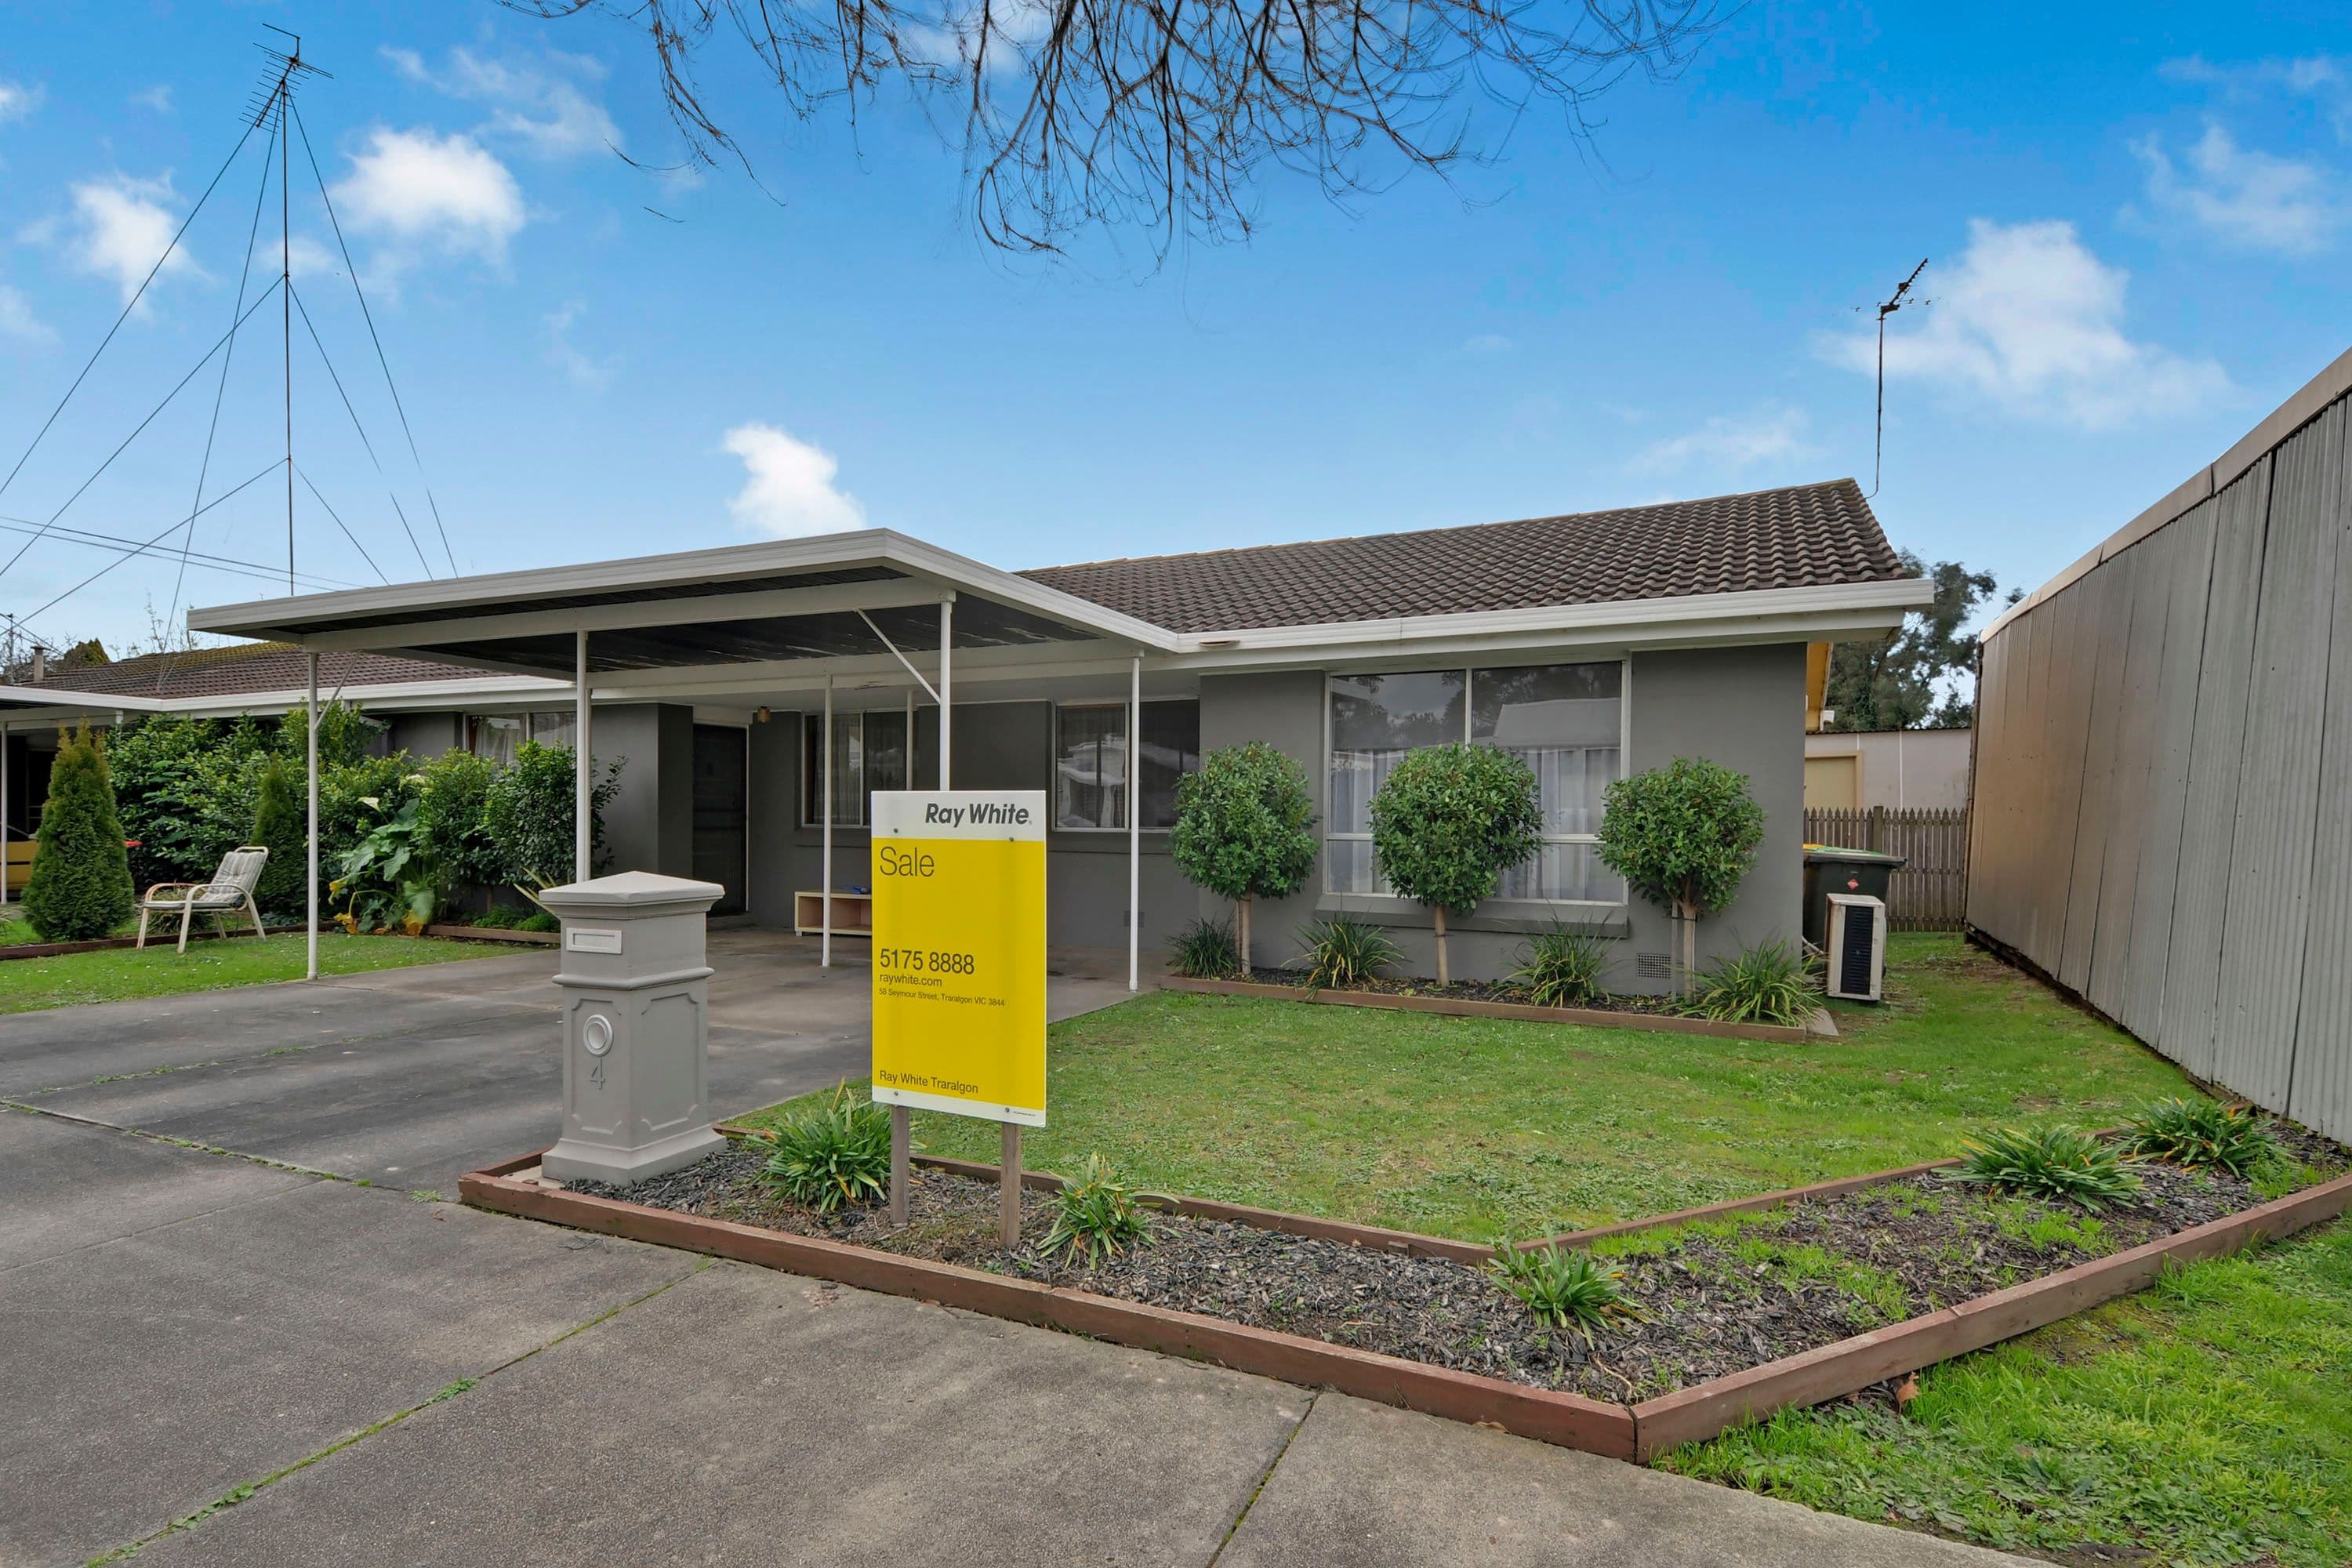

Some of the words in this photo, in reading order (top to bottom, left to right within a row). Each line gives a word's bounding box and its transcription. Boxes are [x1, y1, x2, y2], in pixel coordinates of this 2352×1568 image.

[925, 803, 964, 828] Ray
[880, 846, 935, 877] Sale
[880, 949, 924, 971] 5175
[928, 951, 975, 975] 8888
[880, 973, 942, 987] raywhite.com
[888, 989, 916, 999] Seymour
[918, 992, 939, 1001] Street,
[941, 993, 973, 1005] Traralgon
[974, 996, 986, 1005] VIC
[988, 998, 1005, 1007] 3844
[589, 1058, 606, 1091] 4
[880, 1070, 898, 1085] Ray
[900, 1073, 928, 1087] White
[931, 1077, 978, 1094] Traralgon
